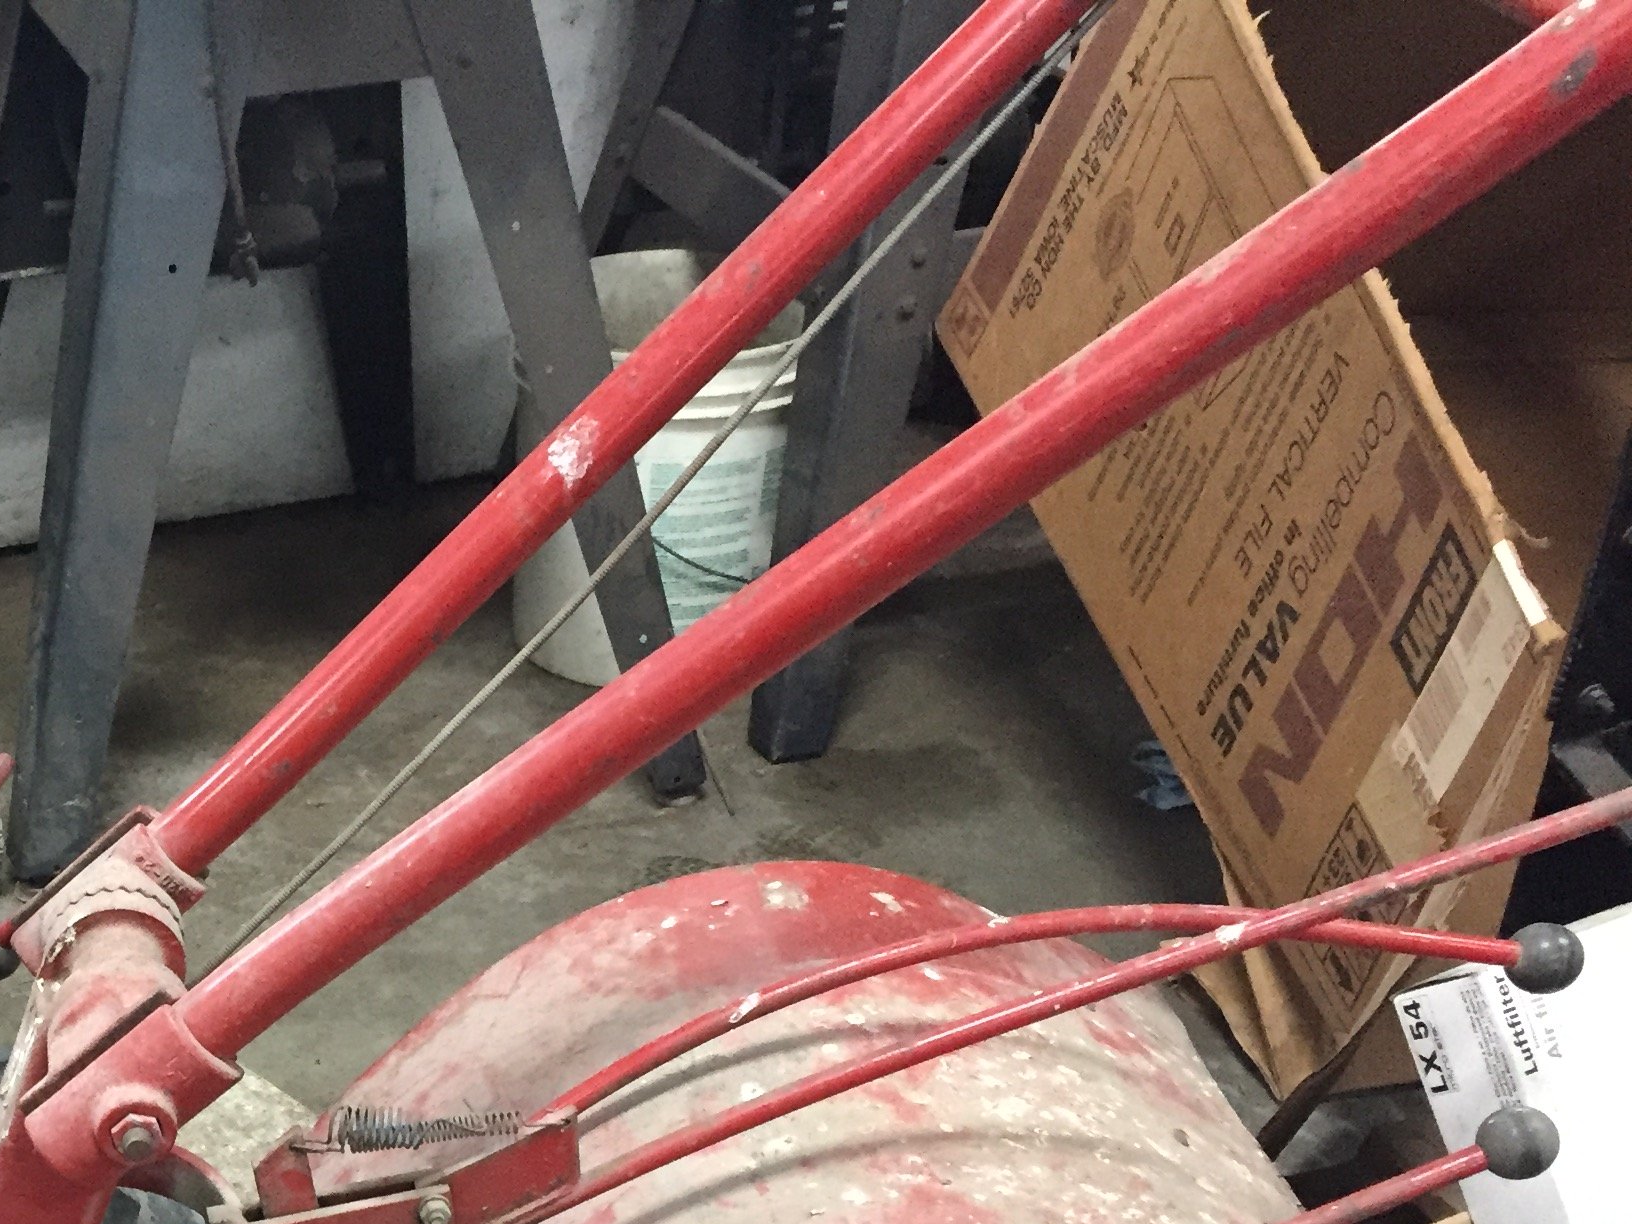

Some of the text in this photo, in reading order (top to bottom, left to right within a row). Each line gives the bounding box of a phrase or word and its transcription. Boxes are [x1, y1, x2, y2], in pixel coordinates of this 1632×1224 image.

[1267, 350, 1350, 502] VERTICAL
[1286, 390, 1396, 599] Compelling
[1233, 503, 1274, 579] FILE
[1400, 539, 1470, 684] FRONT
[1195, 518, 1303, 717] in office furniture
[1209, 599, 1302, 759] VALUE
[1237, 429, 1444, 840] HON
[1402, 999, 1450, 1095] LX 54
[1493, 974, 1539, 1077] Luftfilter
[1544, 1026, 1563, 1059] Air
